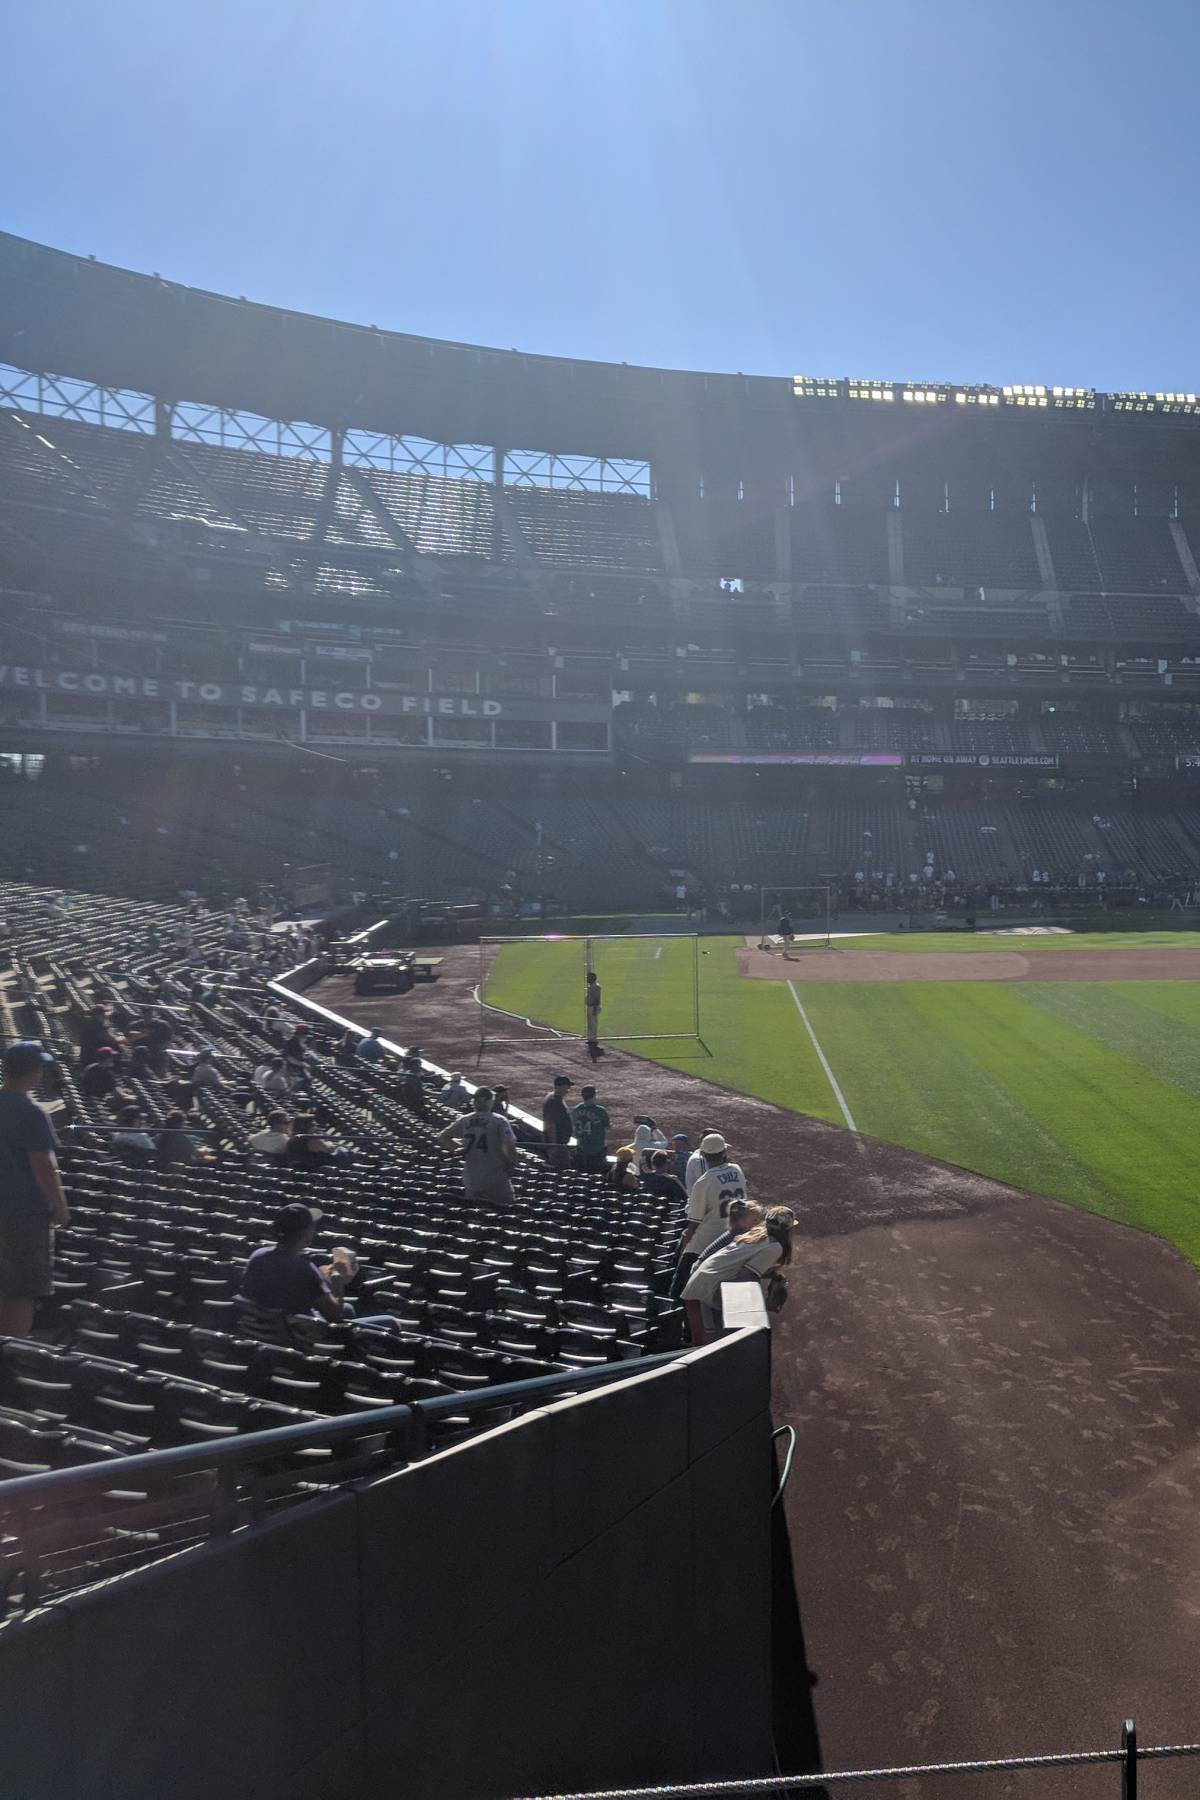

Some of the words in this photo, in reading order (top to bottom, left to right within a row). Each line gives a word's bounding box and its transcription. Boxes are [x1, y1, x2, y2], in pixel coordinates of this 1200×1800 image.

[0, 664, 160, 697] ELCOME
[176, 681, 222, 700] TO
[241, 685, 382, 711] SAFECO
[402, 696, 502, 716] FIELD
[575, 1120, 593, 1134] 34
[463, 1132, 489, 1154] 74
[716, 1171, 740, 1185] CRUZ
